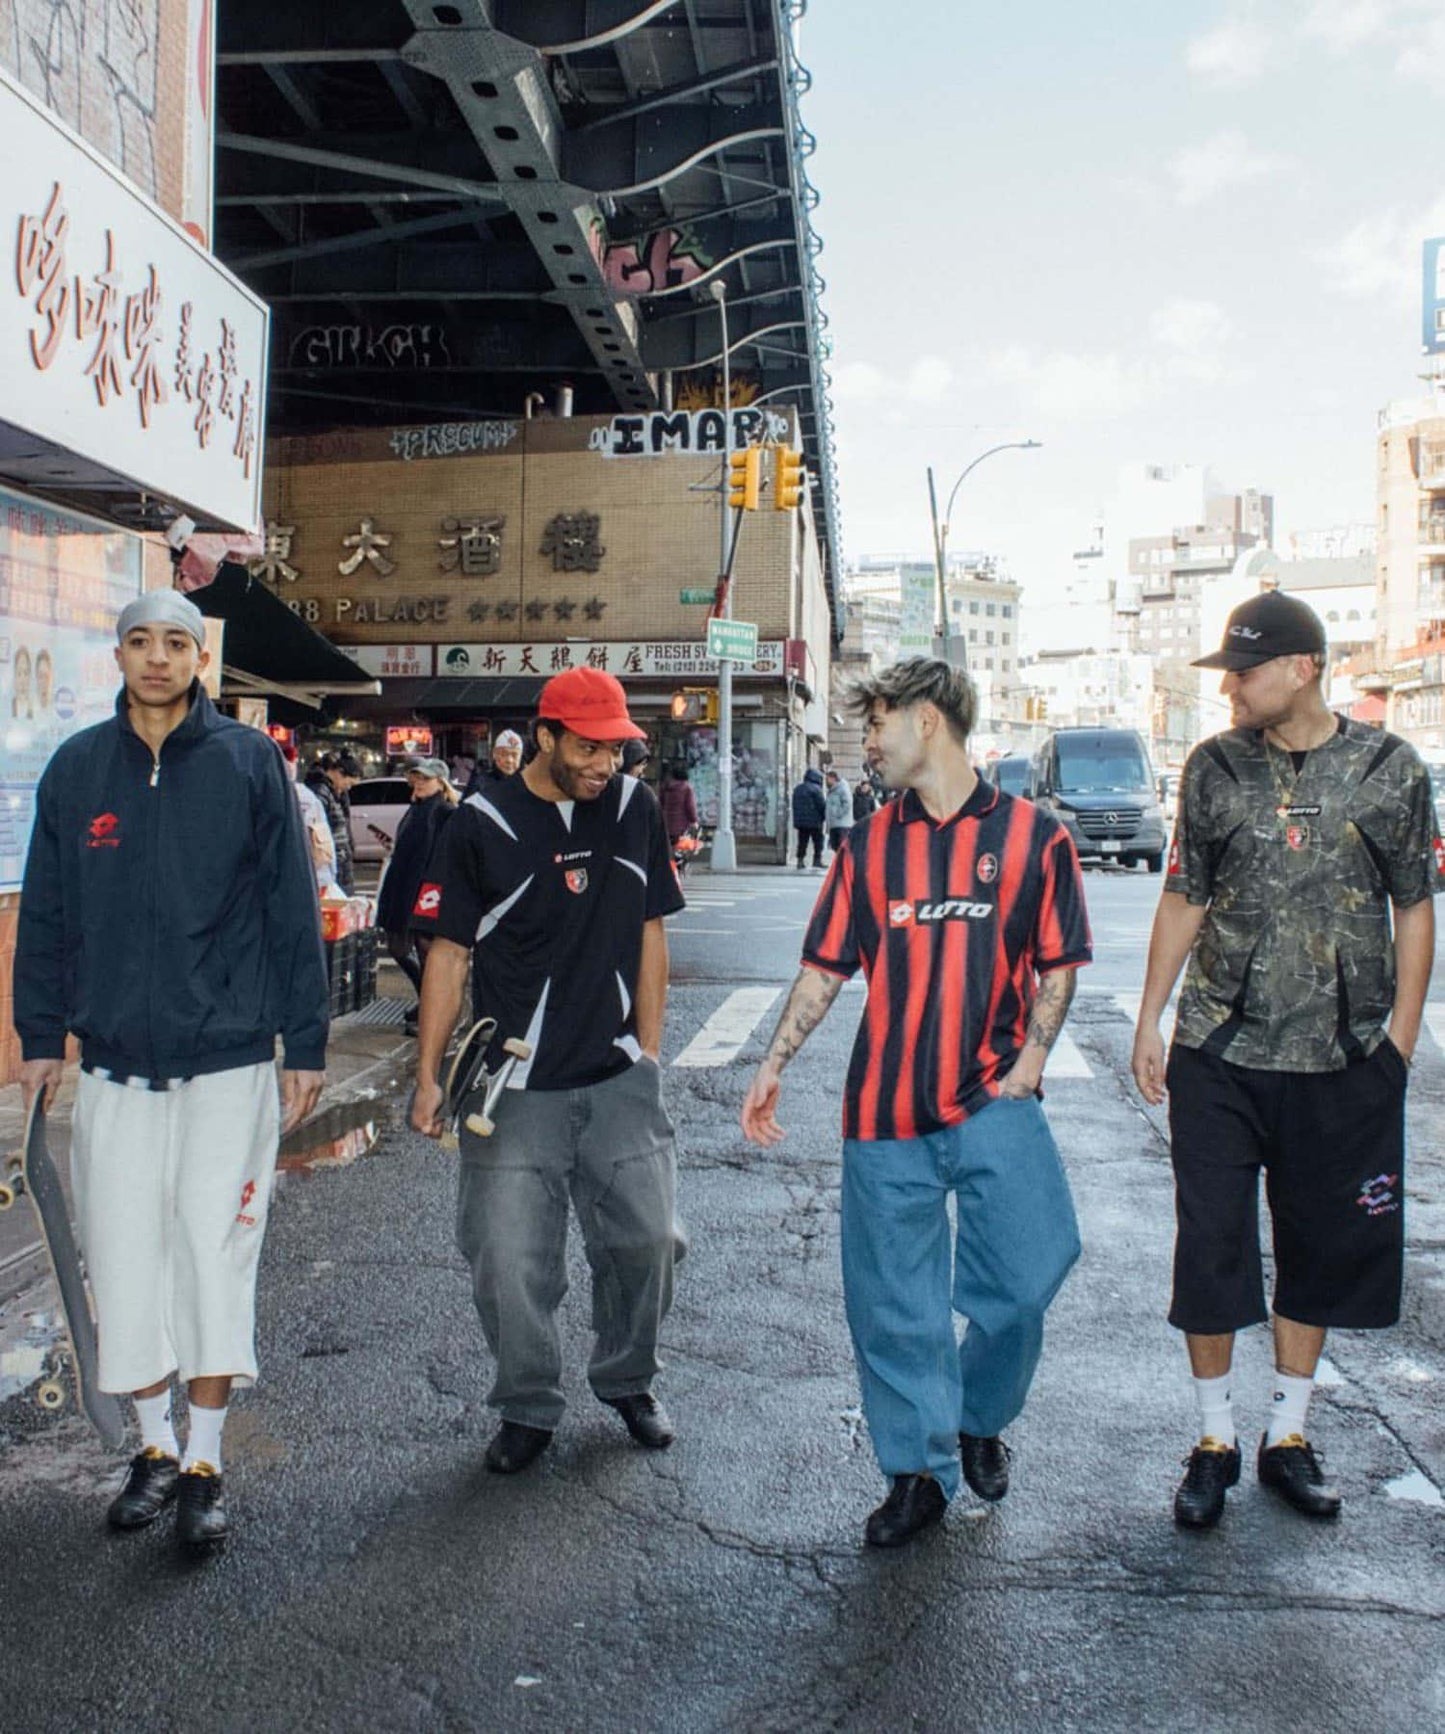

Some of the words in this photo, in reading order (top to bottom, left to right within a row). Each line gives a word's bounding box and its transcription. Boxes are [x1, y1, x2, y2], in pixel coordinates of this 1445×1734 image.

[335, 600, 448, 623] PALACE
[645, 644, 691, 659] FRESH
[918, 900, 993, 919] LOTTO
